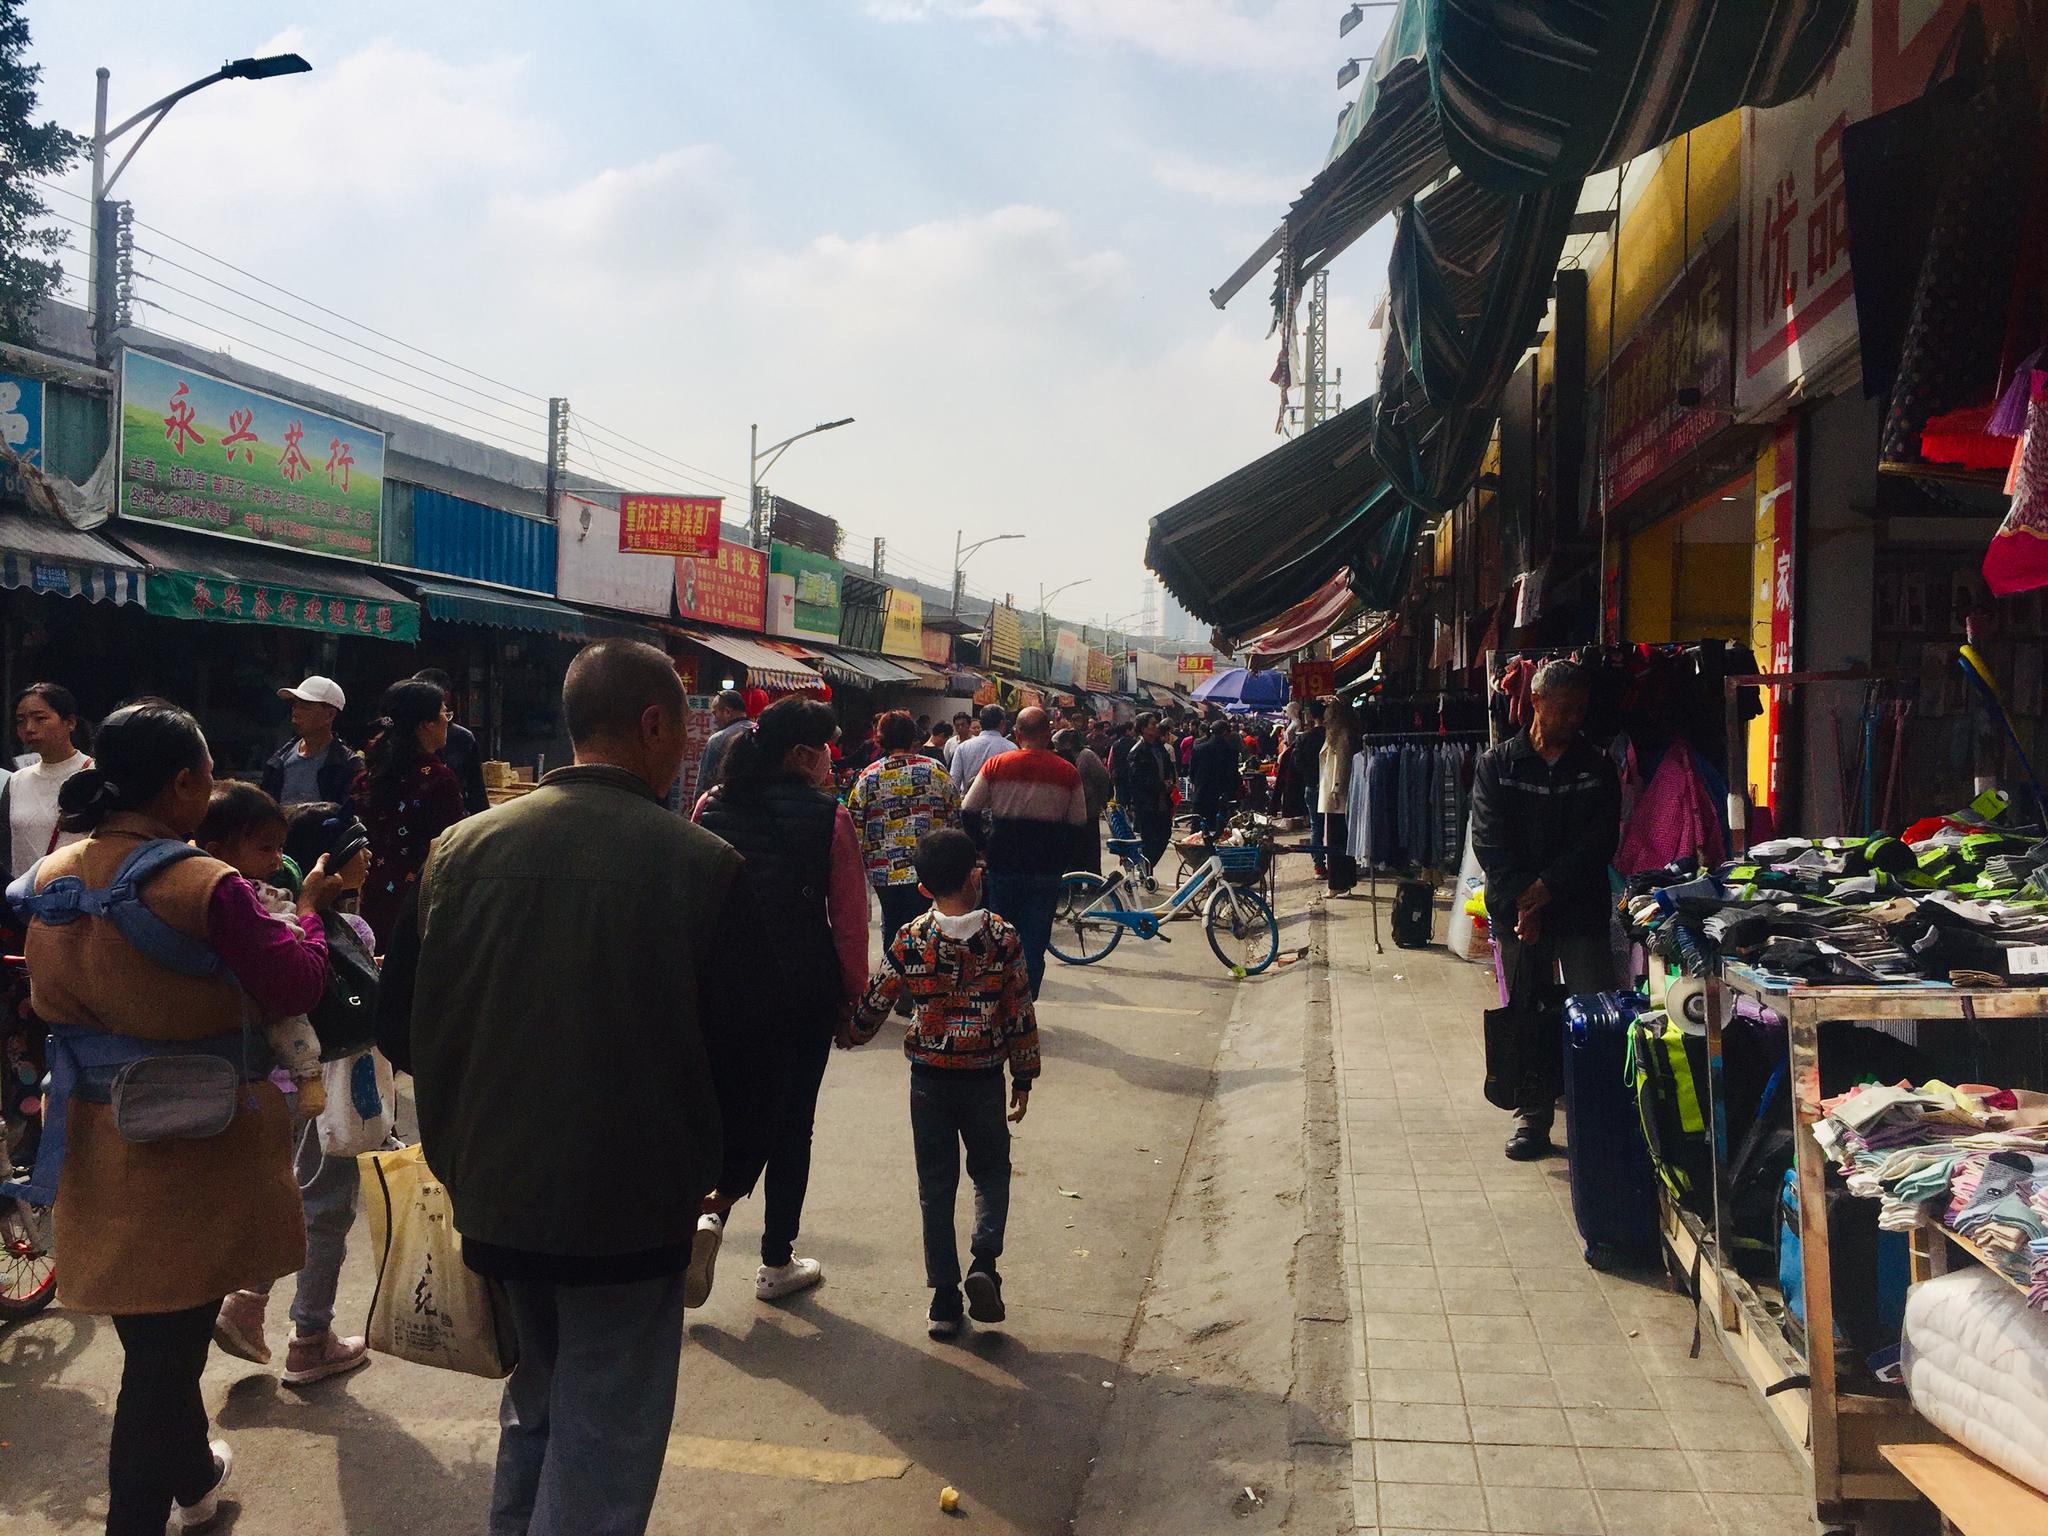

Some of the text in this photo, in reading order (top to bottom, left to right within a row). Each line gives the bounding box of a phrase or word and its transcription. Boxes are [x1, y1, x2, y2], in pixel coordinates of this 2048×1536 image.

[163, 381, 356, 493] 永兴茶行
[170, 466, 207, 492] 铁观音
[128, 486, 232, 527] 各种名茶批发零售
[625, 501, 717, 536] 重庆江津渝溪酒厂
